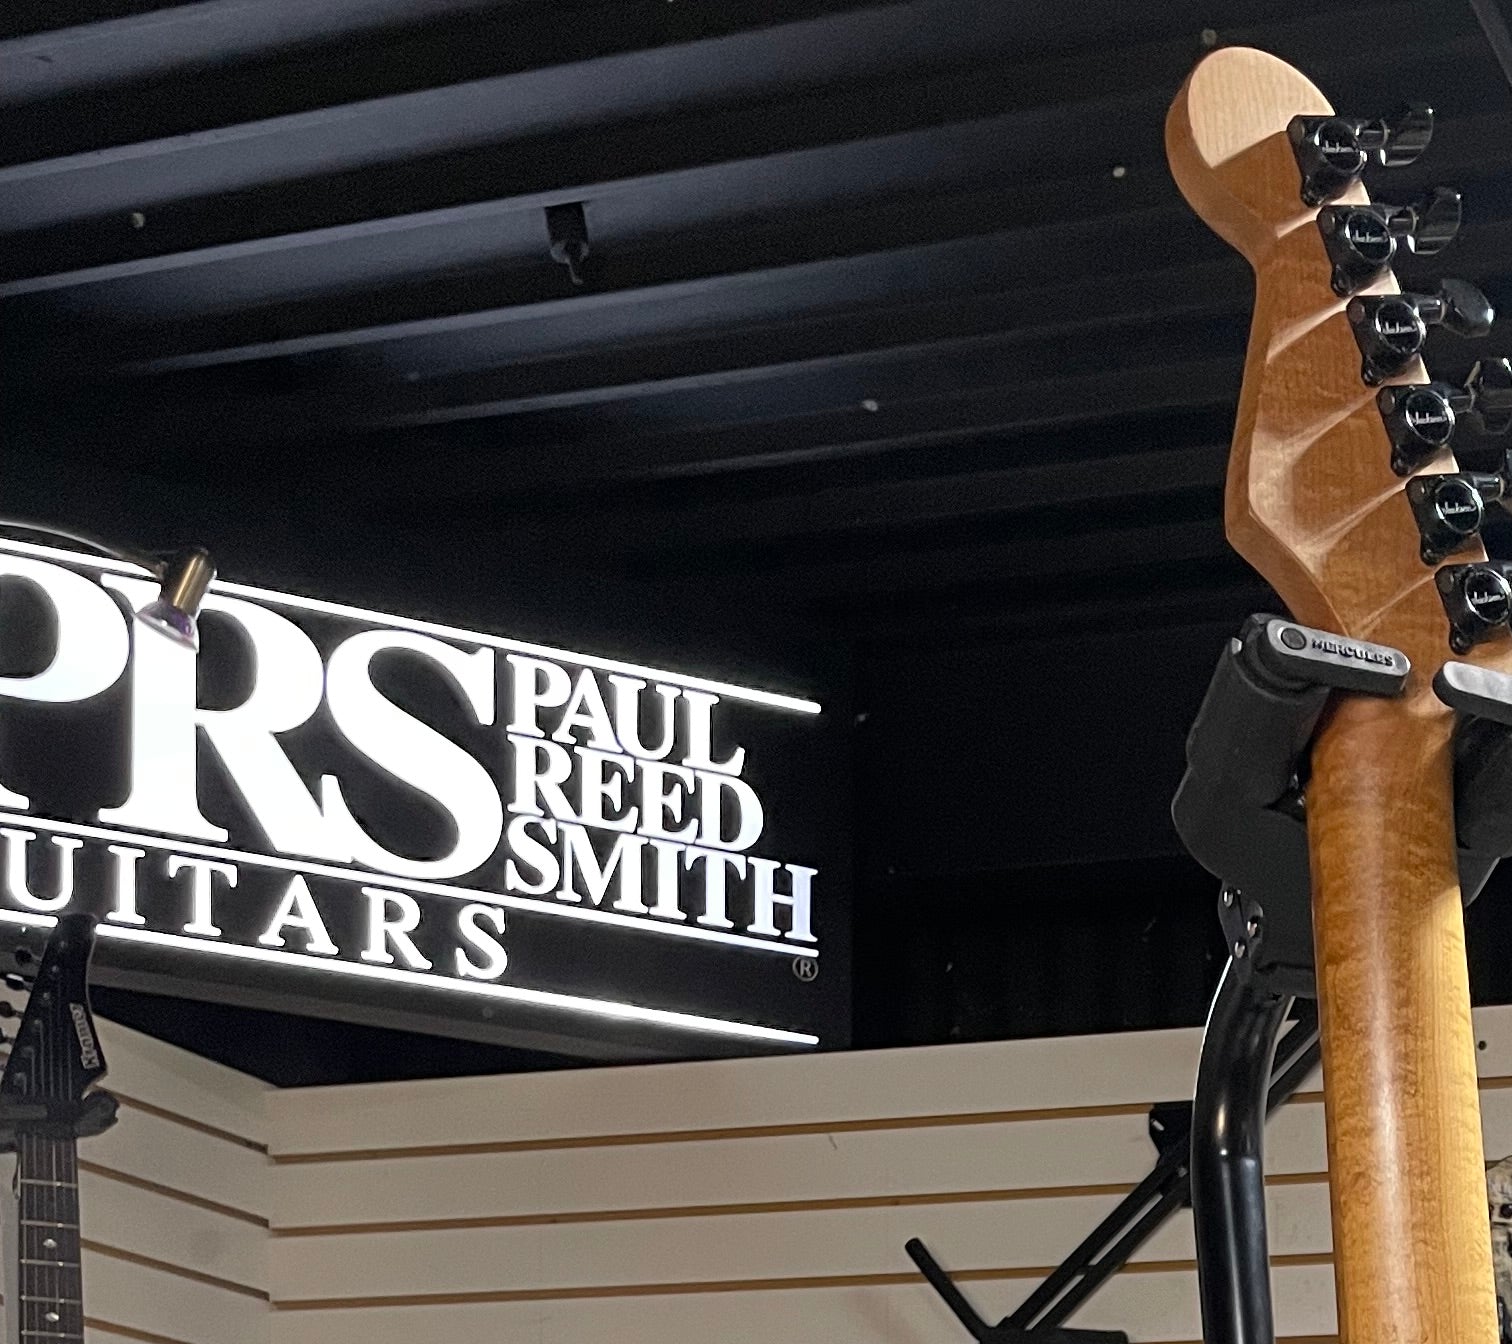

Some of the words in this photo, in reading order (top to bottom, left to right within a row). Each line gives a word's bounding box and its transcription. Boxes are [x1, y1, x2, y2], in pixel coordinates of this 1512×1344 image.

[505, 652, 747, 777] PAUL
[1311, 638, 1394, 667] HERCULES
[506, 733, 766, 854] REED
[0, 830, 509, 982] UITARS
[504, 816, 819, 944] SMITH
